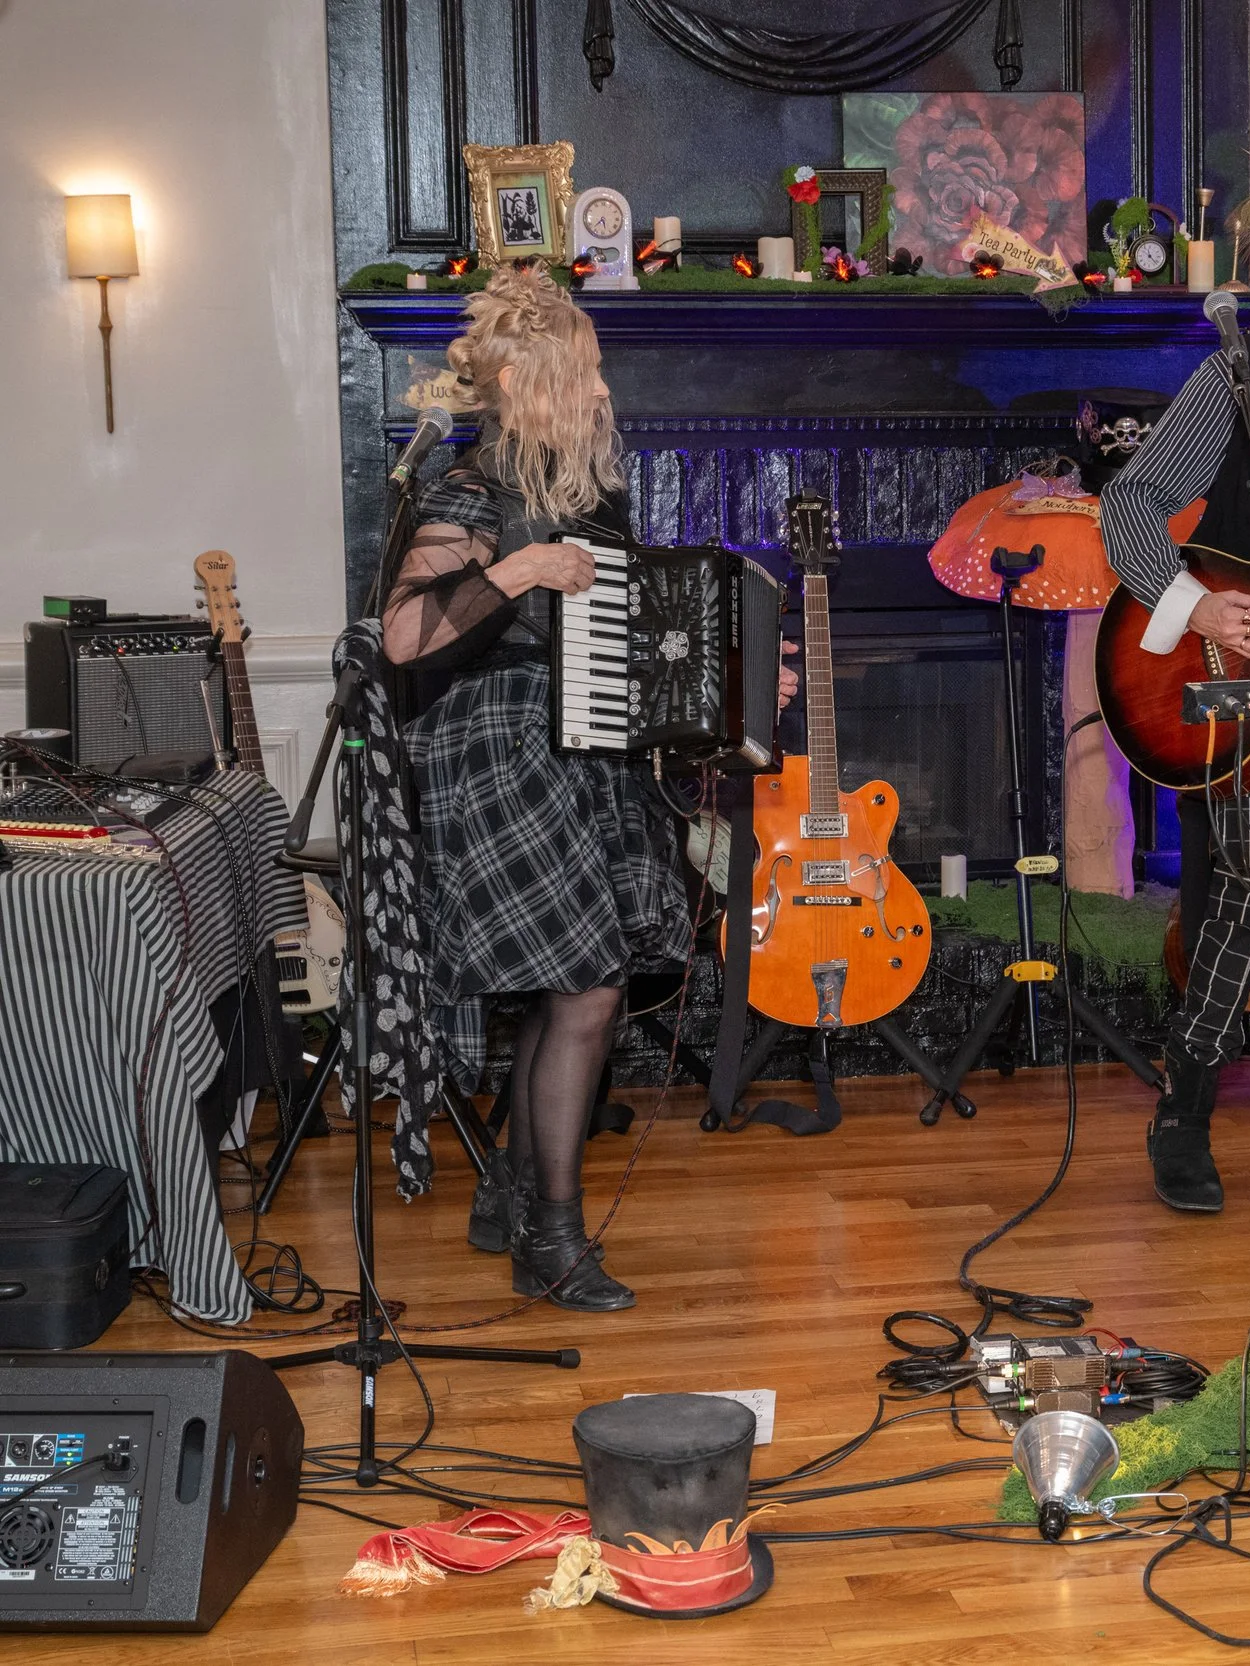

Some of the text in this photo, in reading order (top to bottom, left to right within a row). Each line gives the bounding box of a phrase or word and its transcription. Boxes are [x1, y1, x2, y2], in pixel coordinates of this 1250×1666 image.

[978, 230, 1037, 269] Tea Party
[1041, 501, 1096, 514] Nowhere
[365, 1376, 374, 1408] SAMSON
